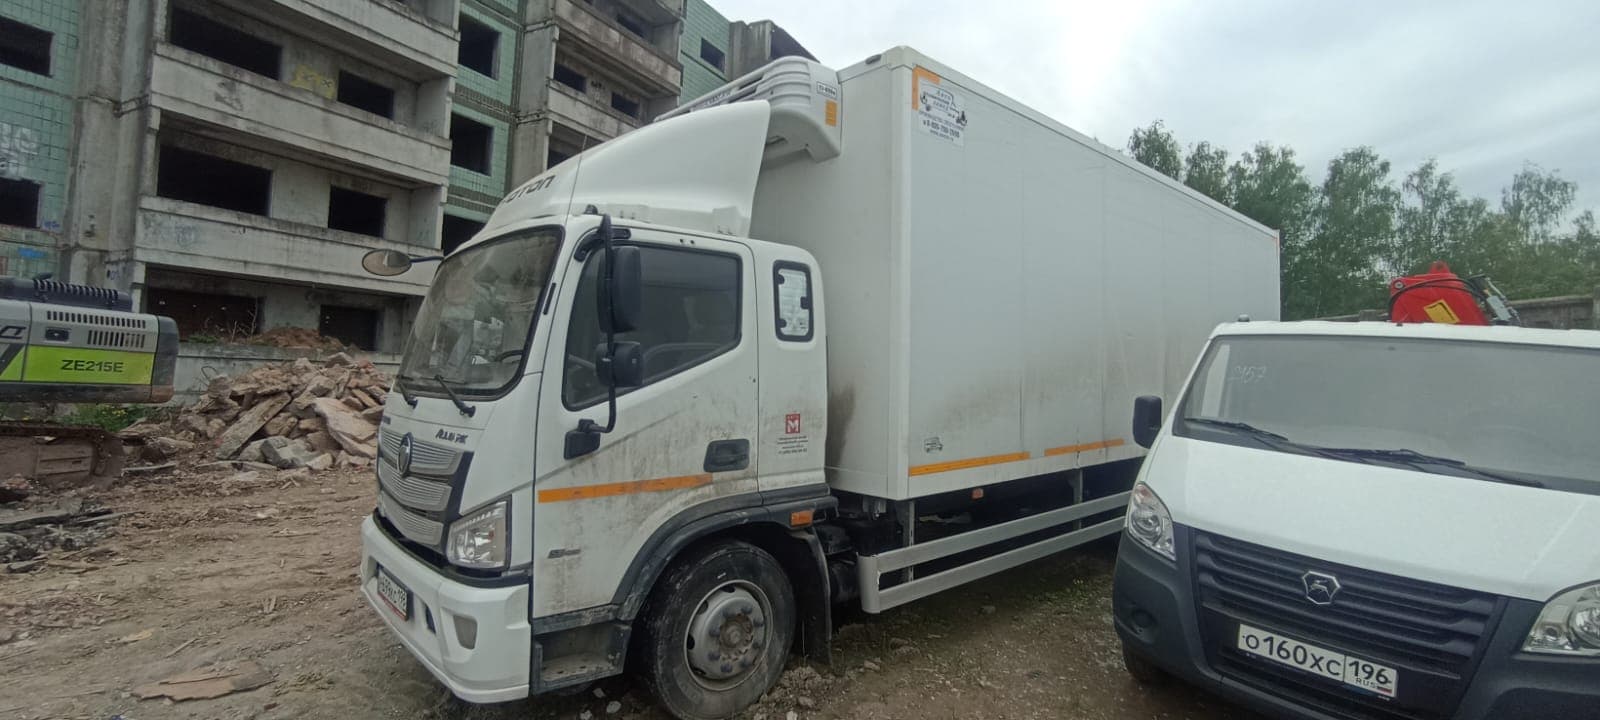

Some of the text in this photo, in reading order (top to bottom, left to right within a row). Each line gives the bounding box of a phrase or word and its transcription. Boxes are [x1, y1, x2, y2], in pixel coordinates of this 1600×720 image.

[61, 358, 124, 373] ZE215E
[1245, 634, 1390, 685] О160ХС 196
[1355, 676, 1377, 689] RUS
